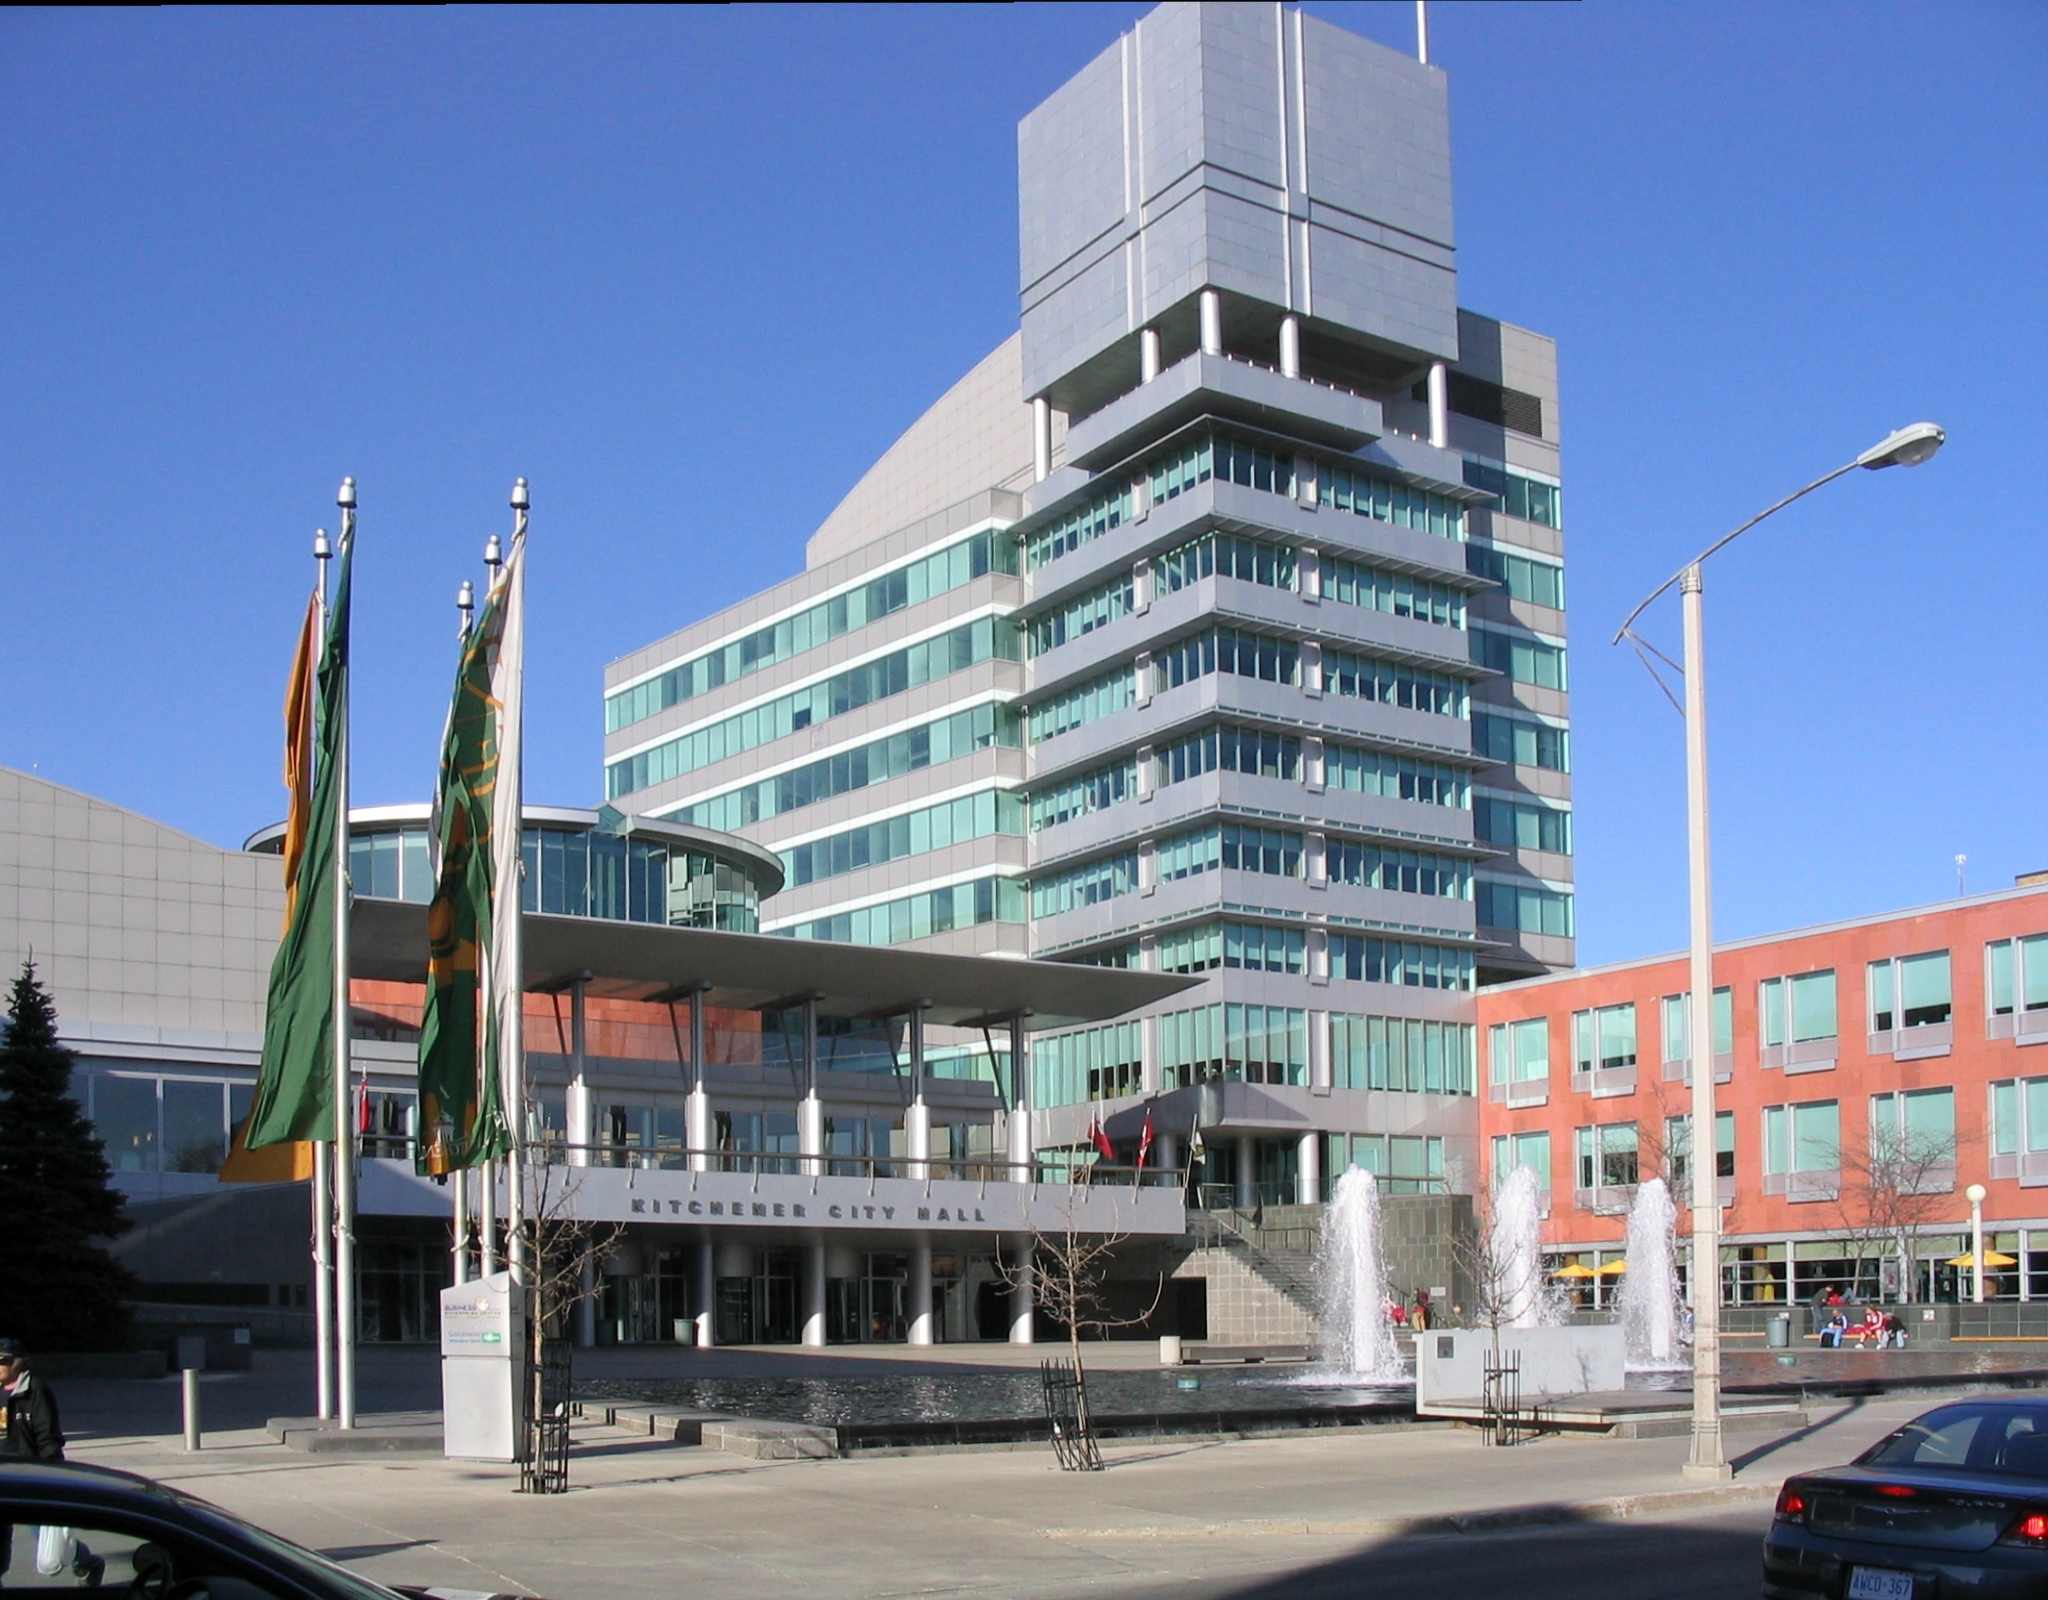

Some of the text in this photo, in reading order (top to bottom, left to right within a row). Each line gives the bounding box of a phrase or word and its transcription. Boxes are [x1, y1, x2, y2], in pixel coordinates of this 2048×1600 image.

[631, 1198, 985, 1222] KITCHENER CITY HALL
